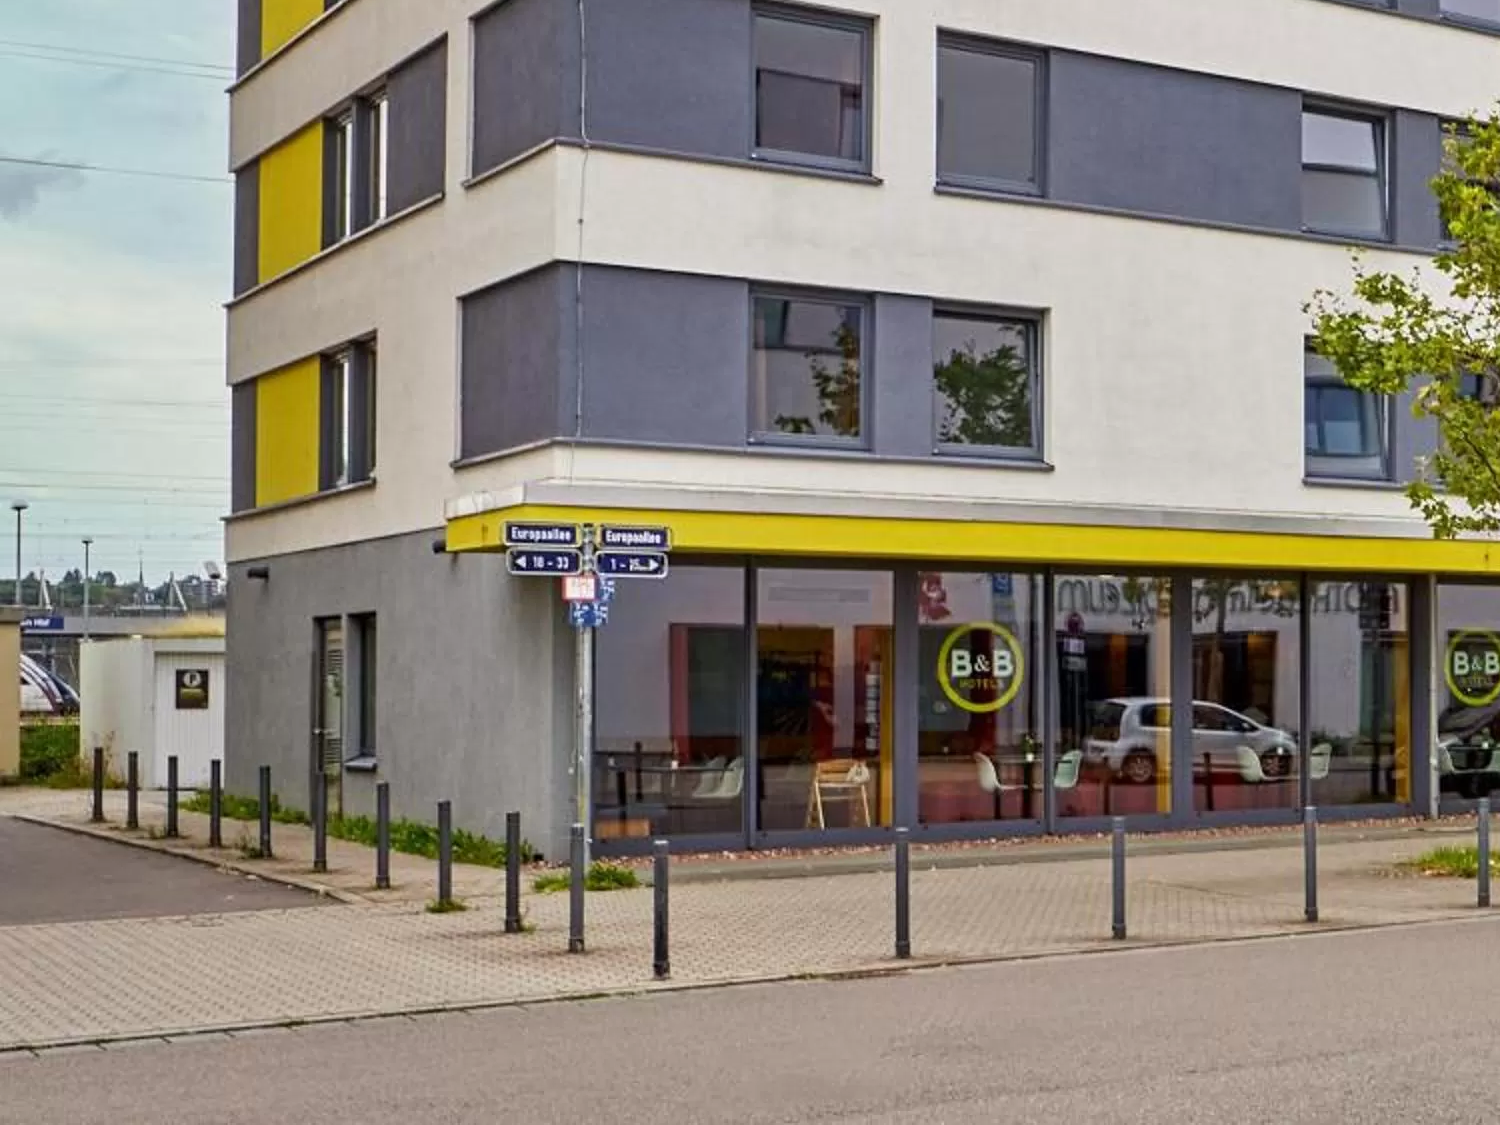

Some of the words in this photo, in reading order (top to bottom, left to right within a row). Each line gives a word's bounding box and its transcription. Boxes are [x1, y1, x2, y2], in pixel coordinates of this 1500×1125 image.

[511, 526, 571, 542] Europaallee
[605, 530, 661, 545] Europaallee
[951, 649, 1013, 677] B&B
[1454, 651, 1500, 675] B&B
